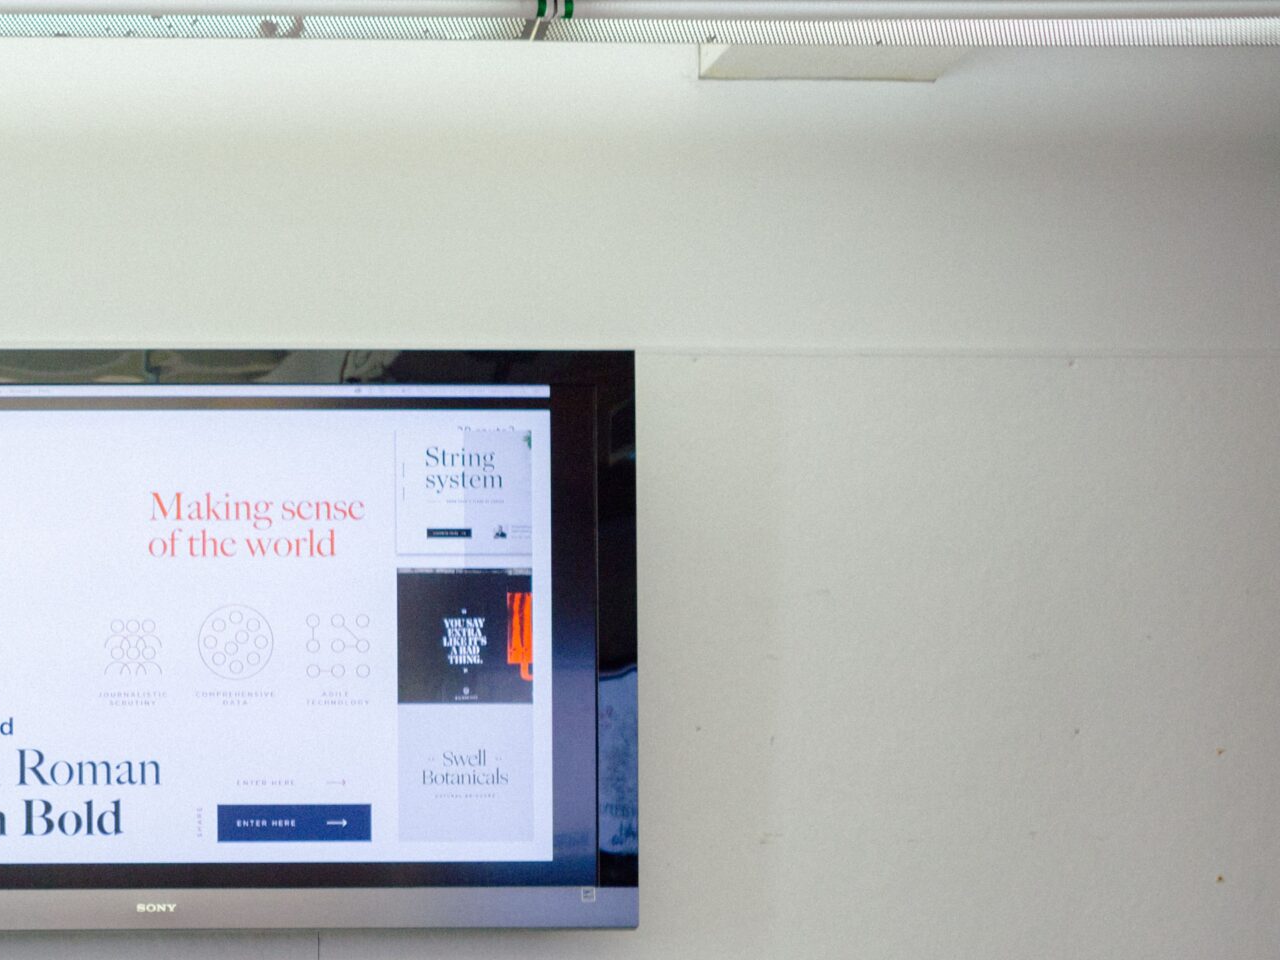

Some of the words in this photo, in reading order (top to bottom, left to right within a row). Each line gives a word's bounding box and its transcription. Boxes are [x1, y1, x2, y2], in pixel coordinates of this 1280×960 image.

[425, 447, 495, 472] String
[425, 471, 502, 494] system
[150, 492, 273, 530] Making
[281, 499, 365, 521] sense
[148, 528, 182, 557] of
[187, 528, 237, 557] the
[245, 528, 336, 557] world
[443, 618, 465, 628] YOU
[466, 617, 485, 628] SAY
[447, 627, 482, 637] EXTRA
[447, 654, 483, 664] THING.
[16, 748, 161, 787] Roman
[442, 749, 487, 767] Swell
[422, 766, 509, 786] Botanicals
[22, 798, 123, 837] Bold
[136, 903, 177, 912] SONY
